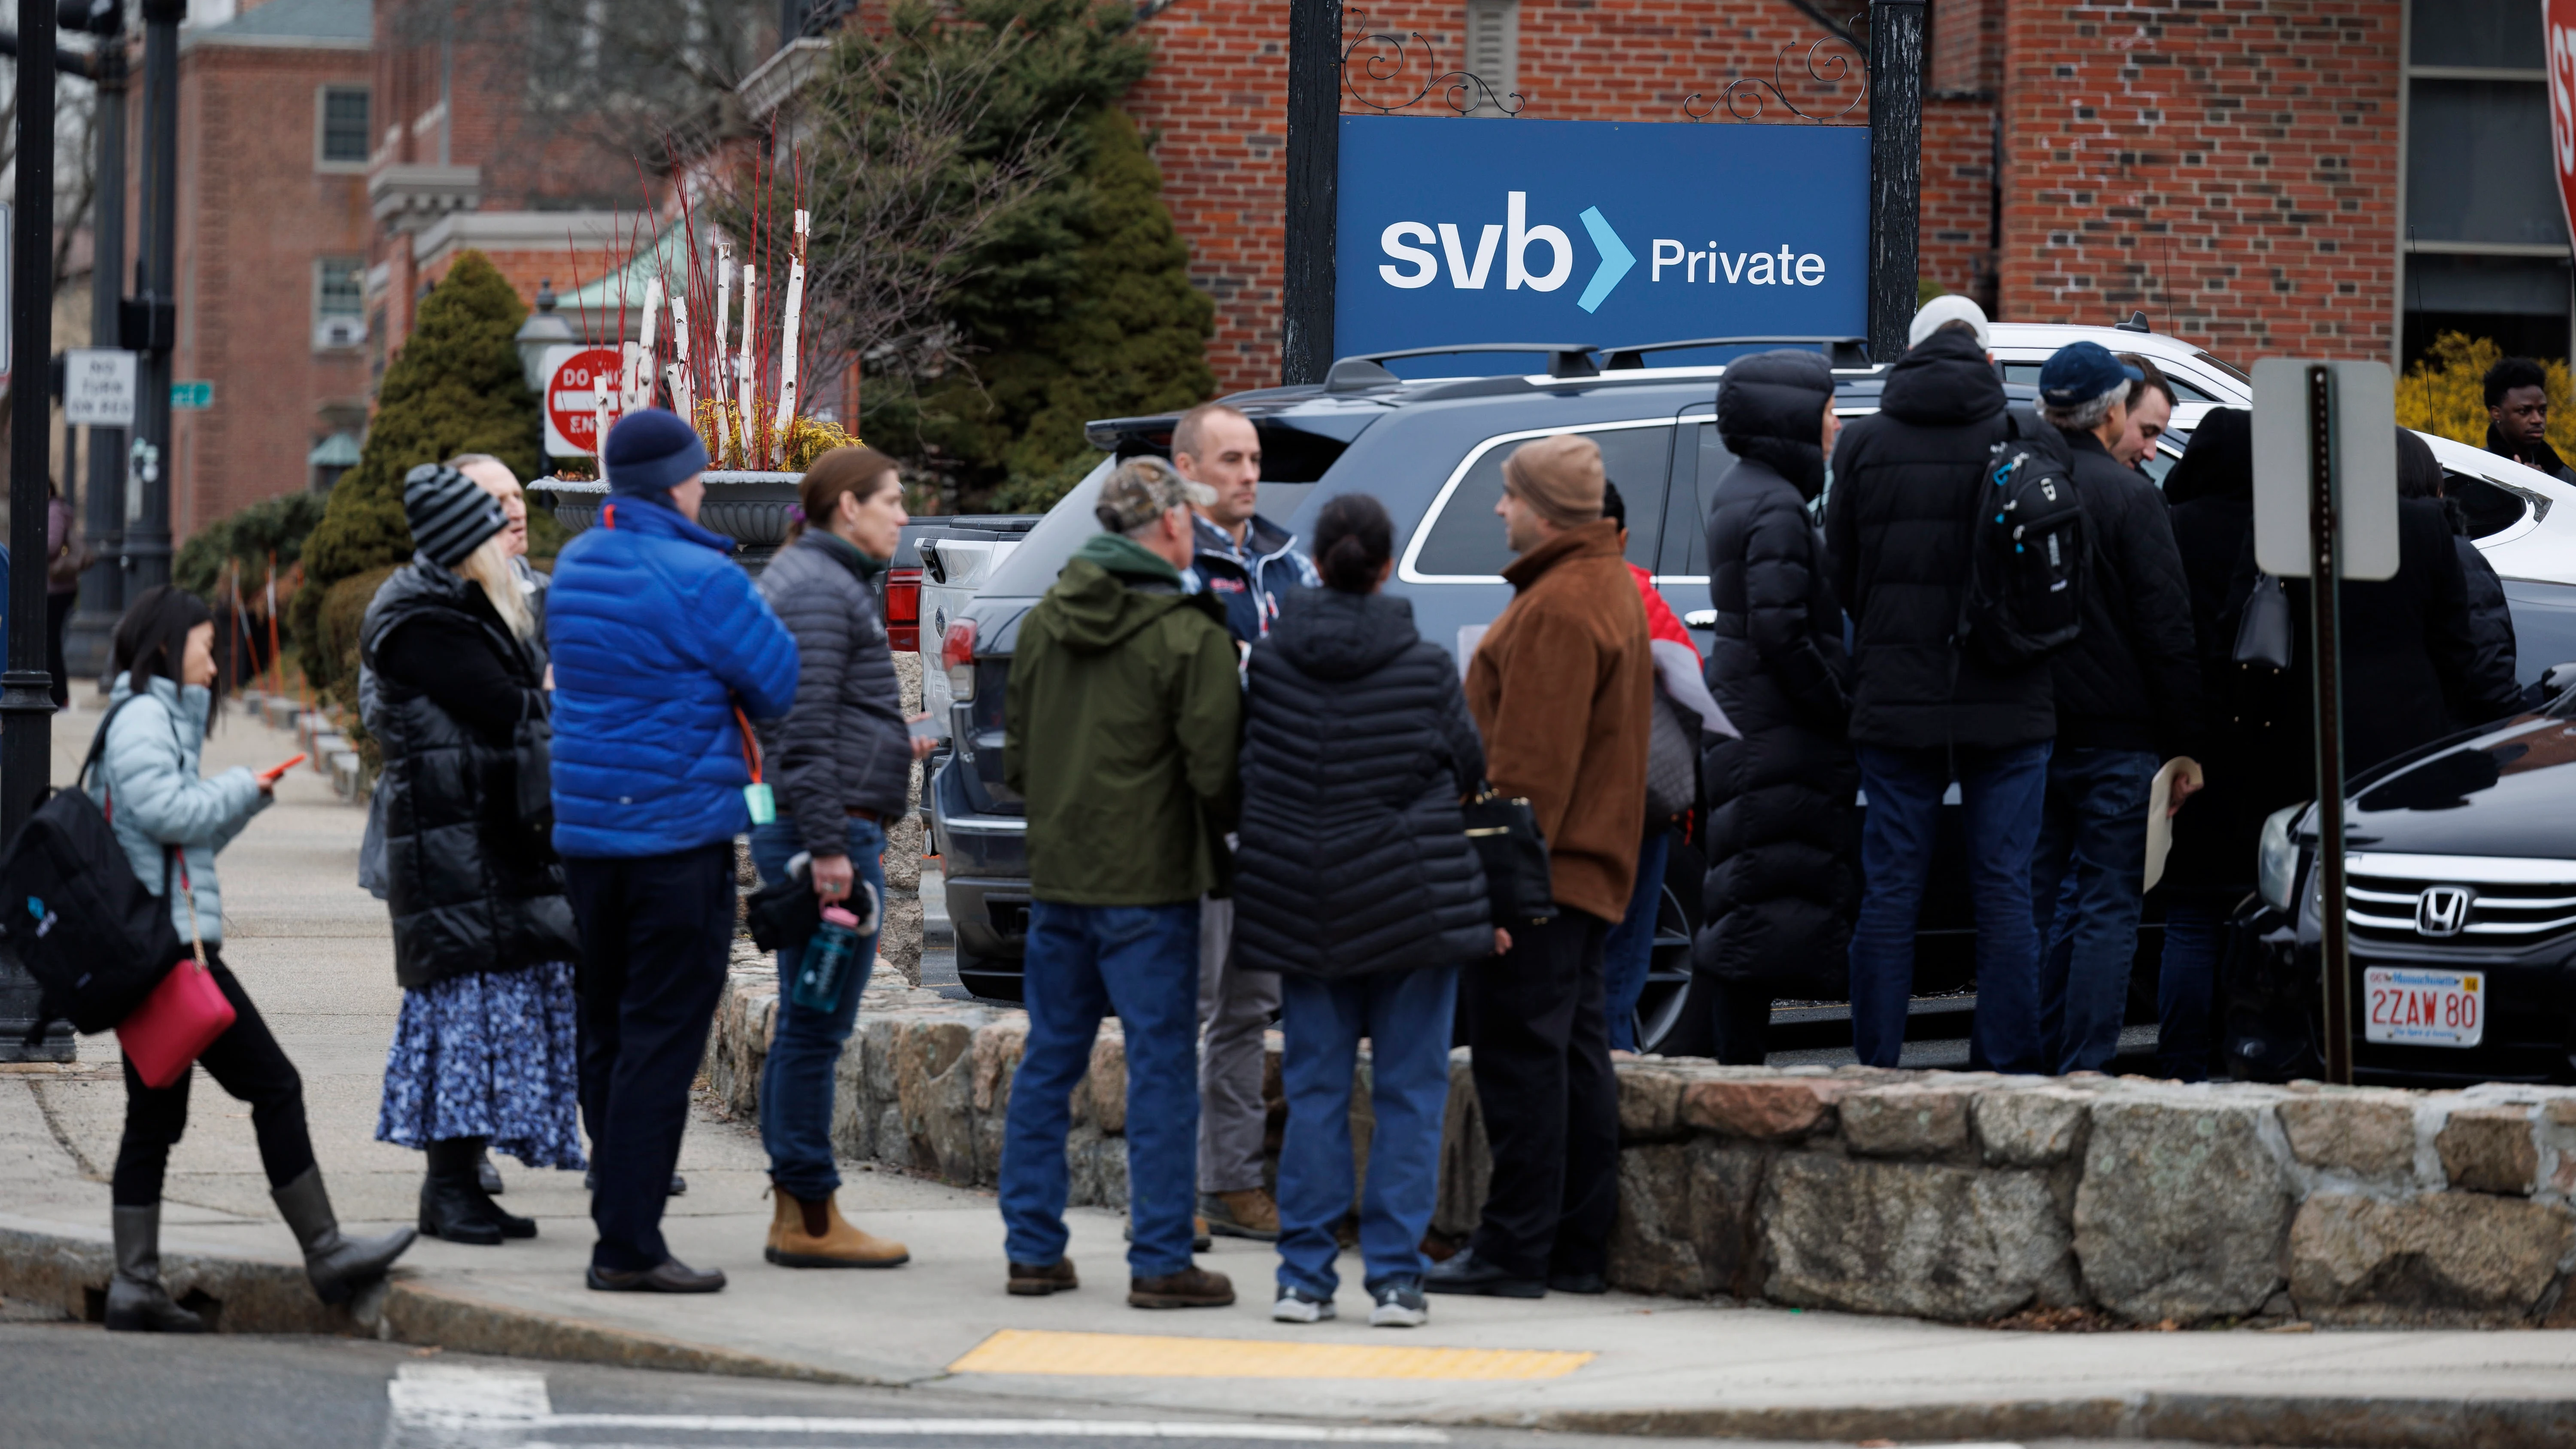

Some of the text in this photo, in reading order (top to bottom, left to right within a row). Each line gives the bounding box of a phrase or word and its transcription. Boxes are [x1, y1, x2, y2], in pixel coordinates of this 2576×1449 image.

[1379, 191, 1826, 292] svb Private
[89, 360, 116, 376] NO
[563, 368, 589, 386] DO
[82, 377, 124, 395] TURN
[2372, 988, 2476, 1028] 2ZAW 80
